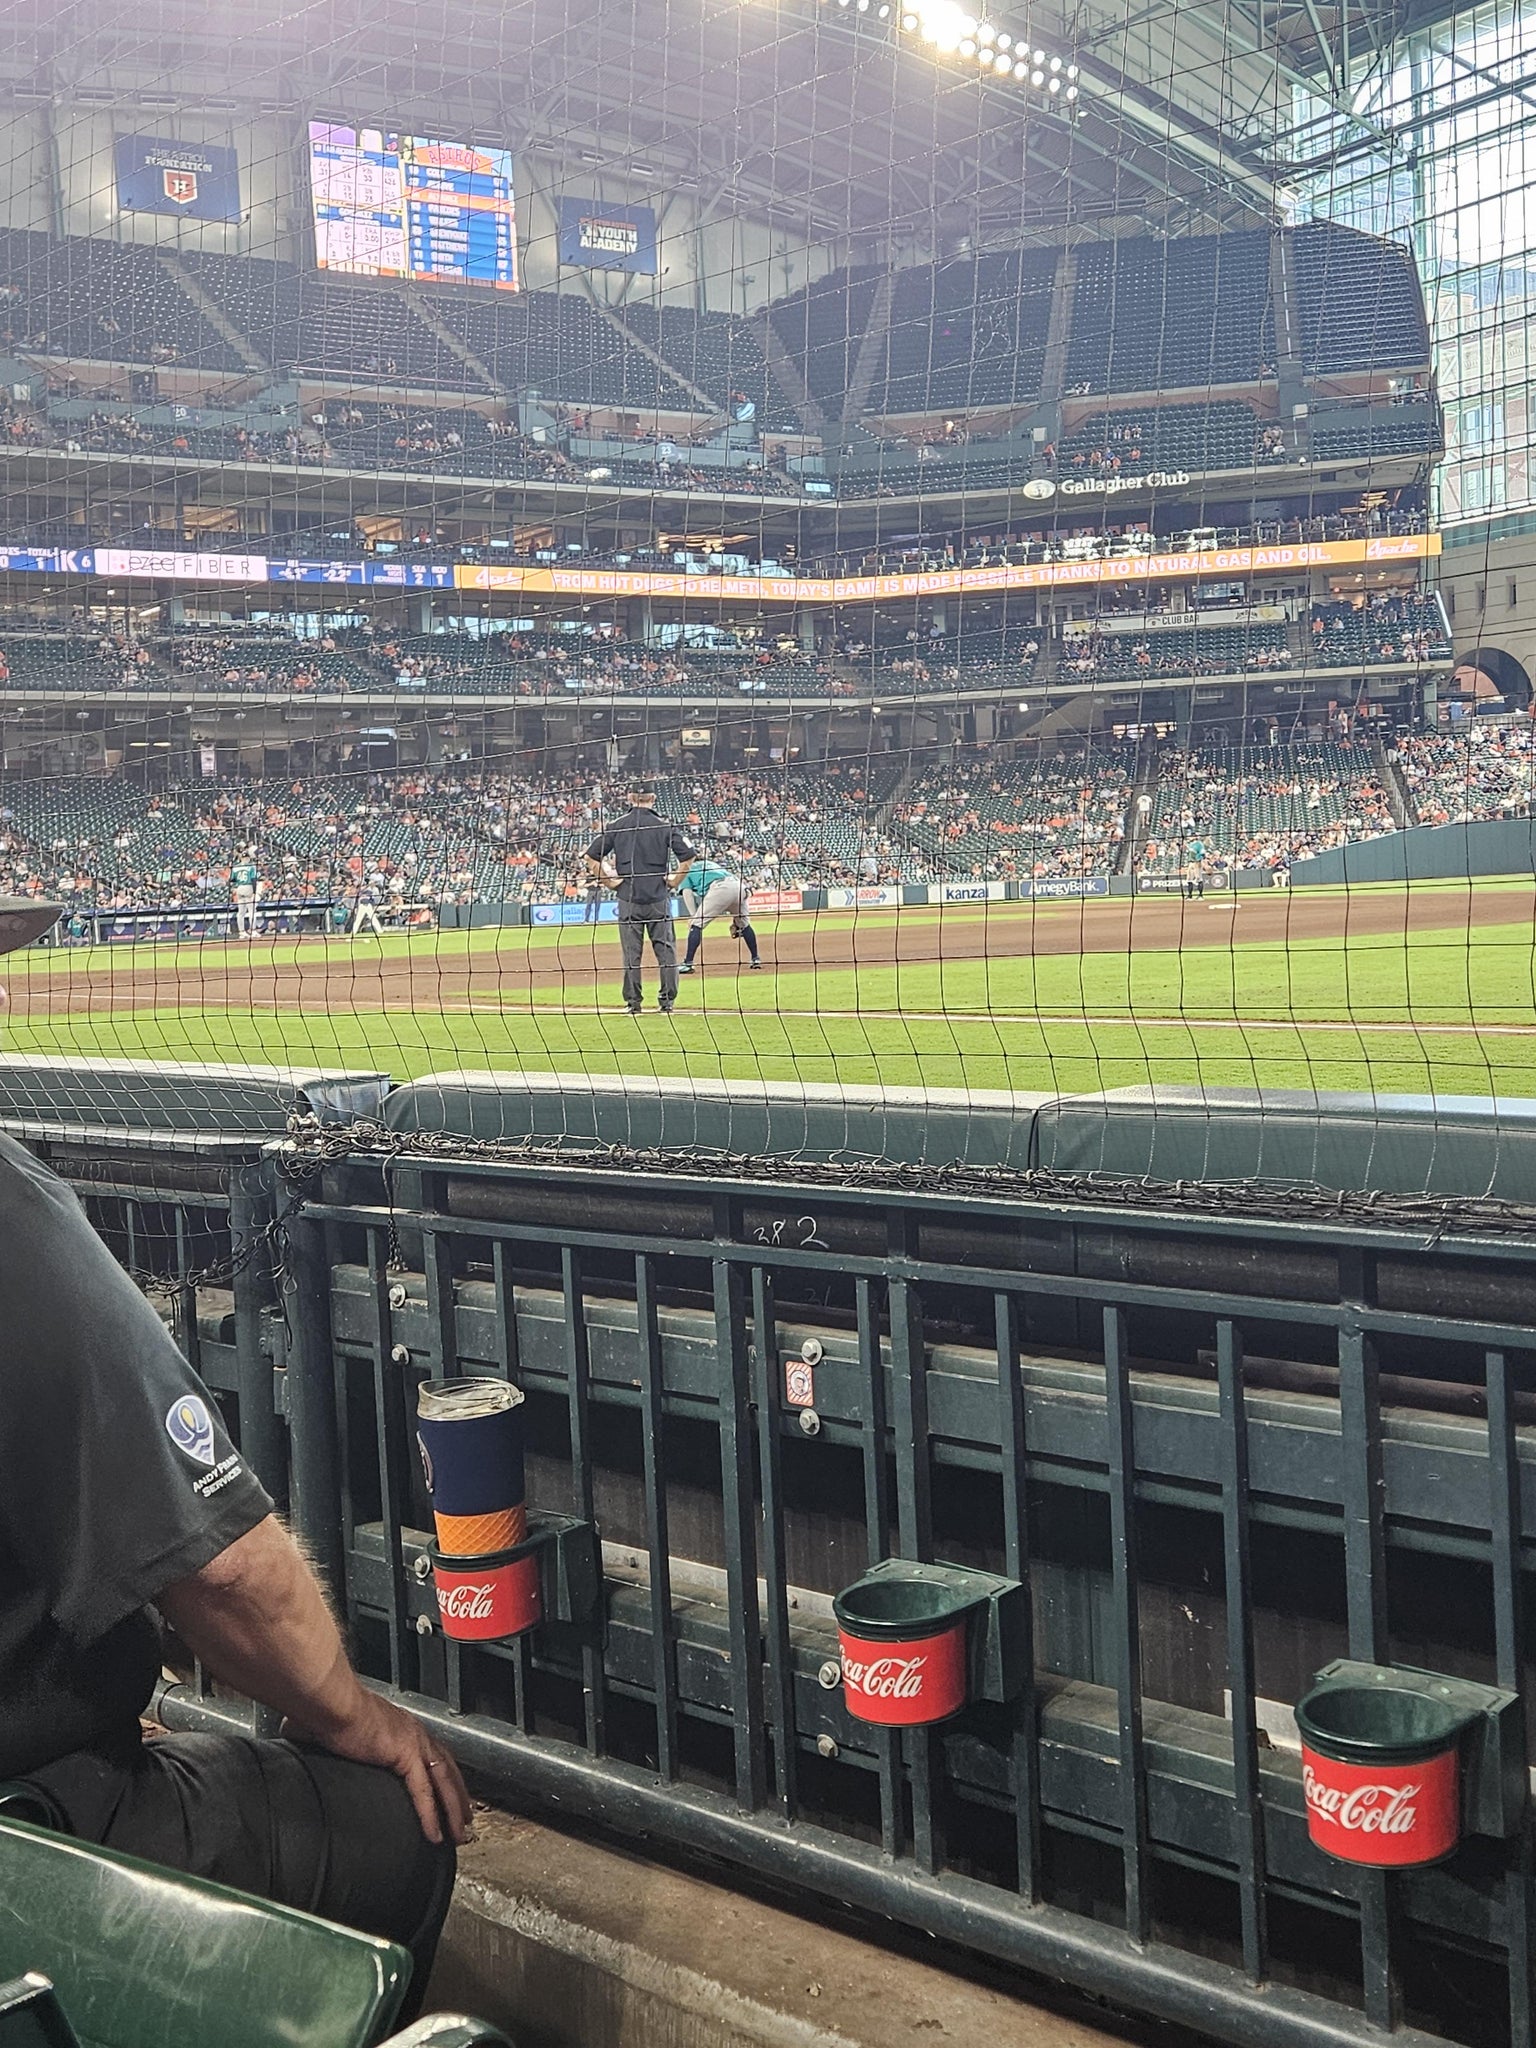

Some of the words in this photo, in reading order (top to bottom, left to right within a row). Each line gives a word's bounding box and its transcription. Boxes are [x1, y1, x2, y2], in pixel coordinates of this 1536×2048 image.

[144, 155, 213, 173] FOUNDATION
[428, 147, 481, 169] ASTROS
[598, 226, 638, 242] YOUTH
[580, 235, 638, 253] ACADEMY
[1061, 475, 1144, 495] Gallagher
[1147, 470, 1190, 487] Club
[81, 556, 91, 568] 6
[129, 556, 174, 571] ezee
[183, 559, 251, 575] FIBER
[552, 574, 594, 589] FROM
[600, 576, 630, 590] HOT
[633, 577, 674, 591] DOGS
[771, 582, 830, 596] TODAY'S
[834, 581, 880, 597] GAME
[884, 579, 900, 593] IS
[903, 576, 950, 593] MADE
[1037, 564, 1104, 582] THANKS
[1108, 561, 1130, 576] TO
[1134, 555, 1212, 575] NATURAL
[1215, 551, 1250, 568] GAS
[1255, 549, 1293, 565] AND
[1297, 546, 1331, 562] OIL.
[1367, 538, 1418, 558] Apache
[1162, 615, 1182, 625] CLUB
[1184, 614, 1200, 623] BAR
[192, 1468, 219, 1493] ANDY
[202, 1466, 242, 1498] SERVICES
